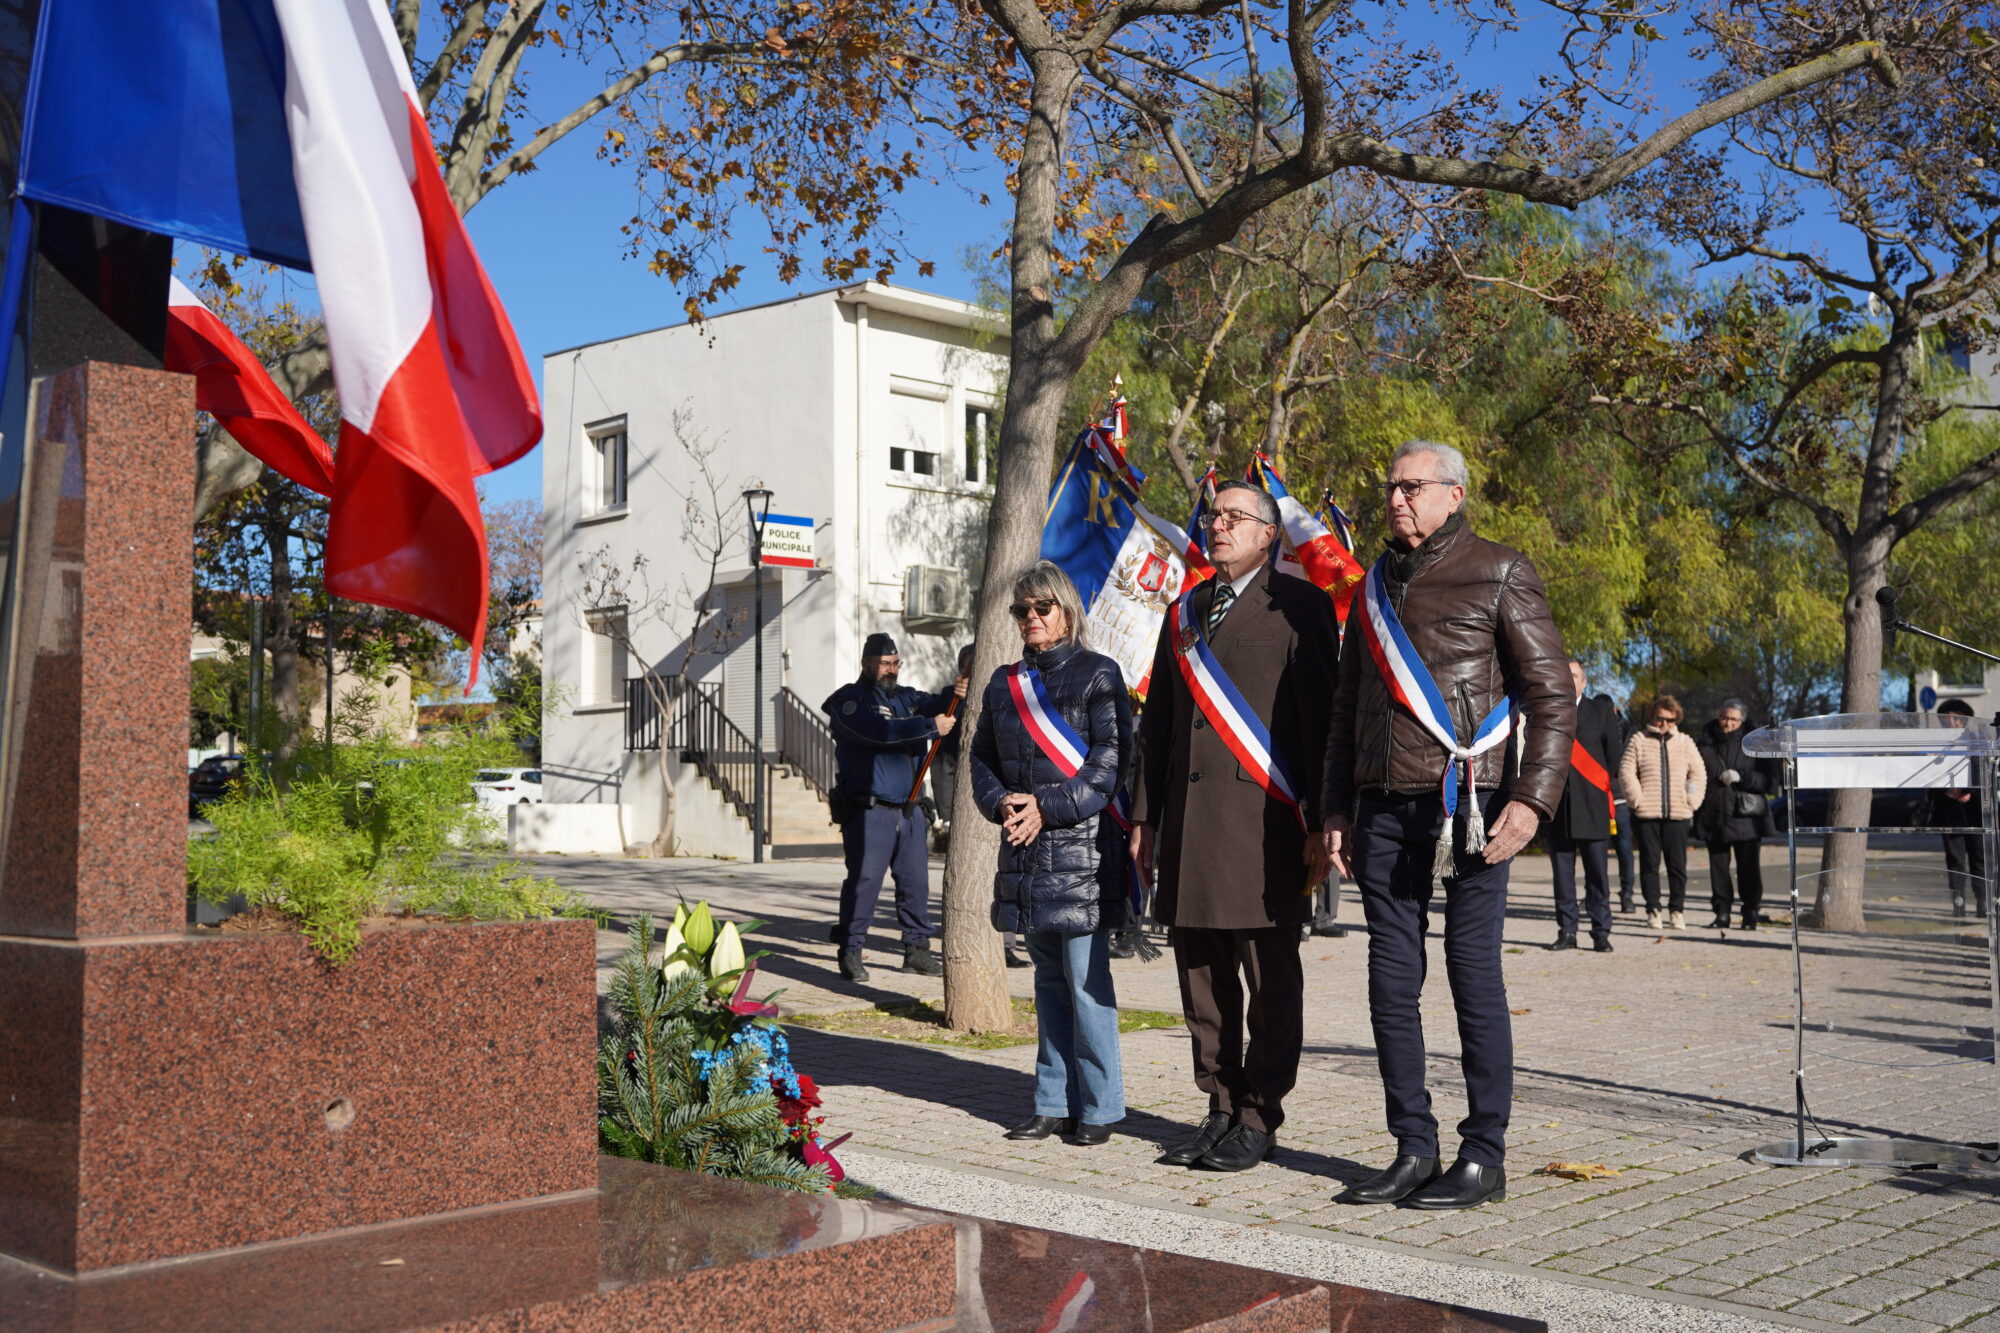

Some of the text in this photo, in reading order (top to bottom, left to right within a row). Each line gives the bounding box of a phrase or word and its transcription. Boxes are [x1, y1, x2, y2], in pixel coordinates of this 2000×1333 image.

[769, 528, 801, 539] POLICE
[760, 541, 812, 553] MUNICIPALE
[1311, 537, 1346, 569] SECTIO
[1089, 591, 1139, 638] VILLE
